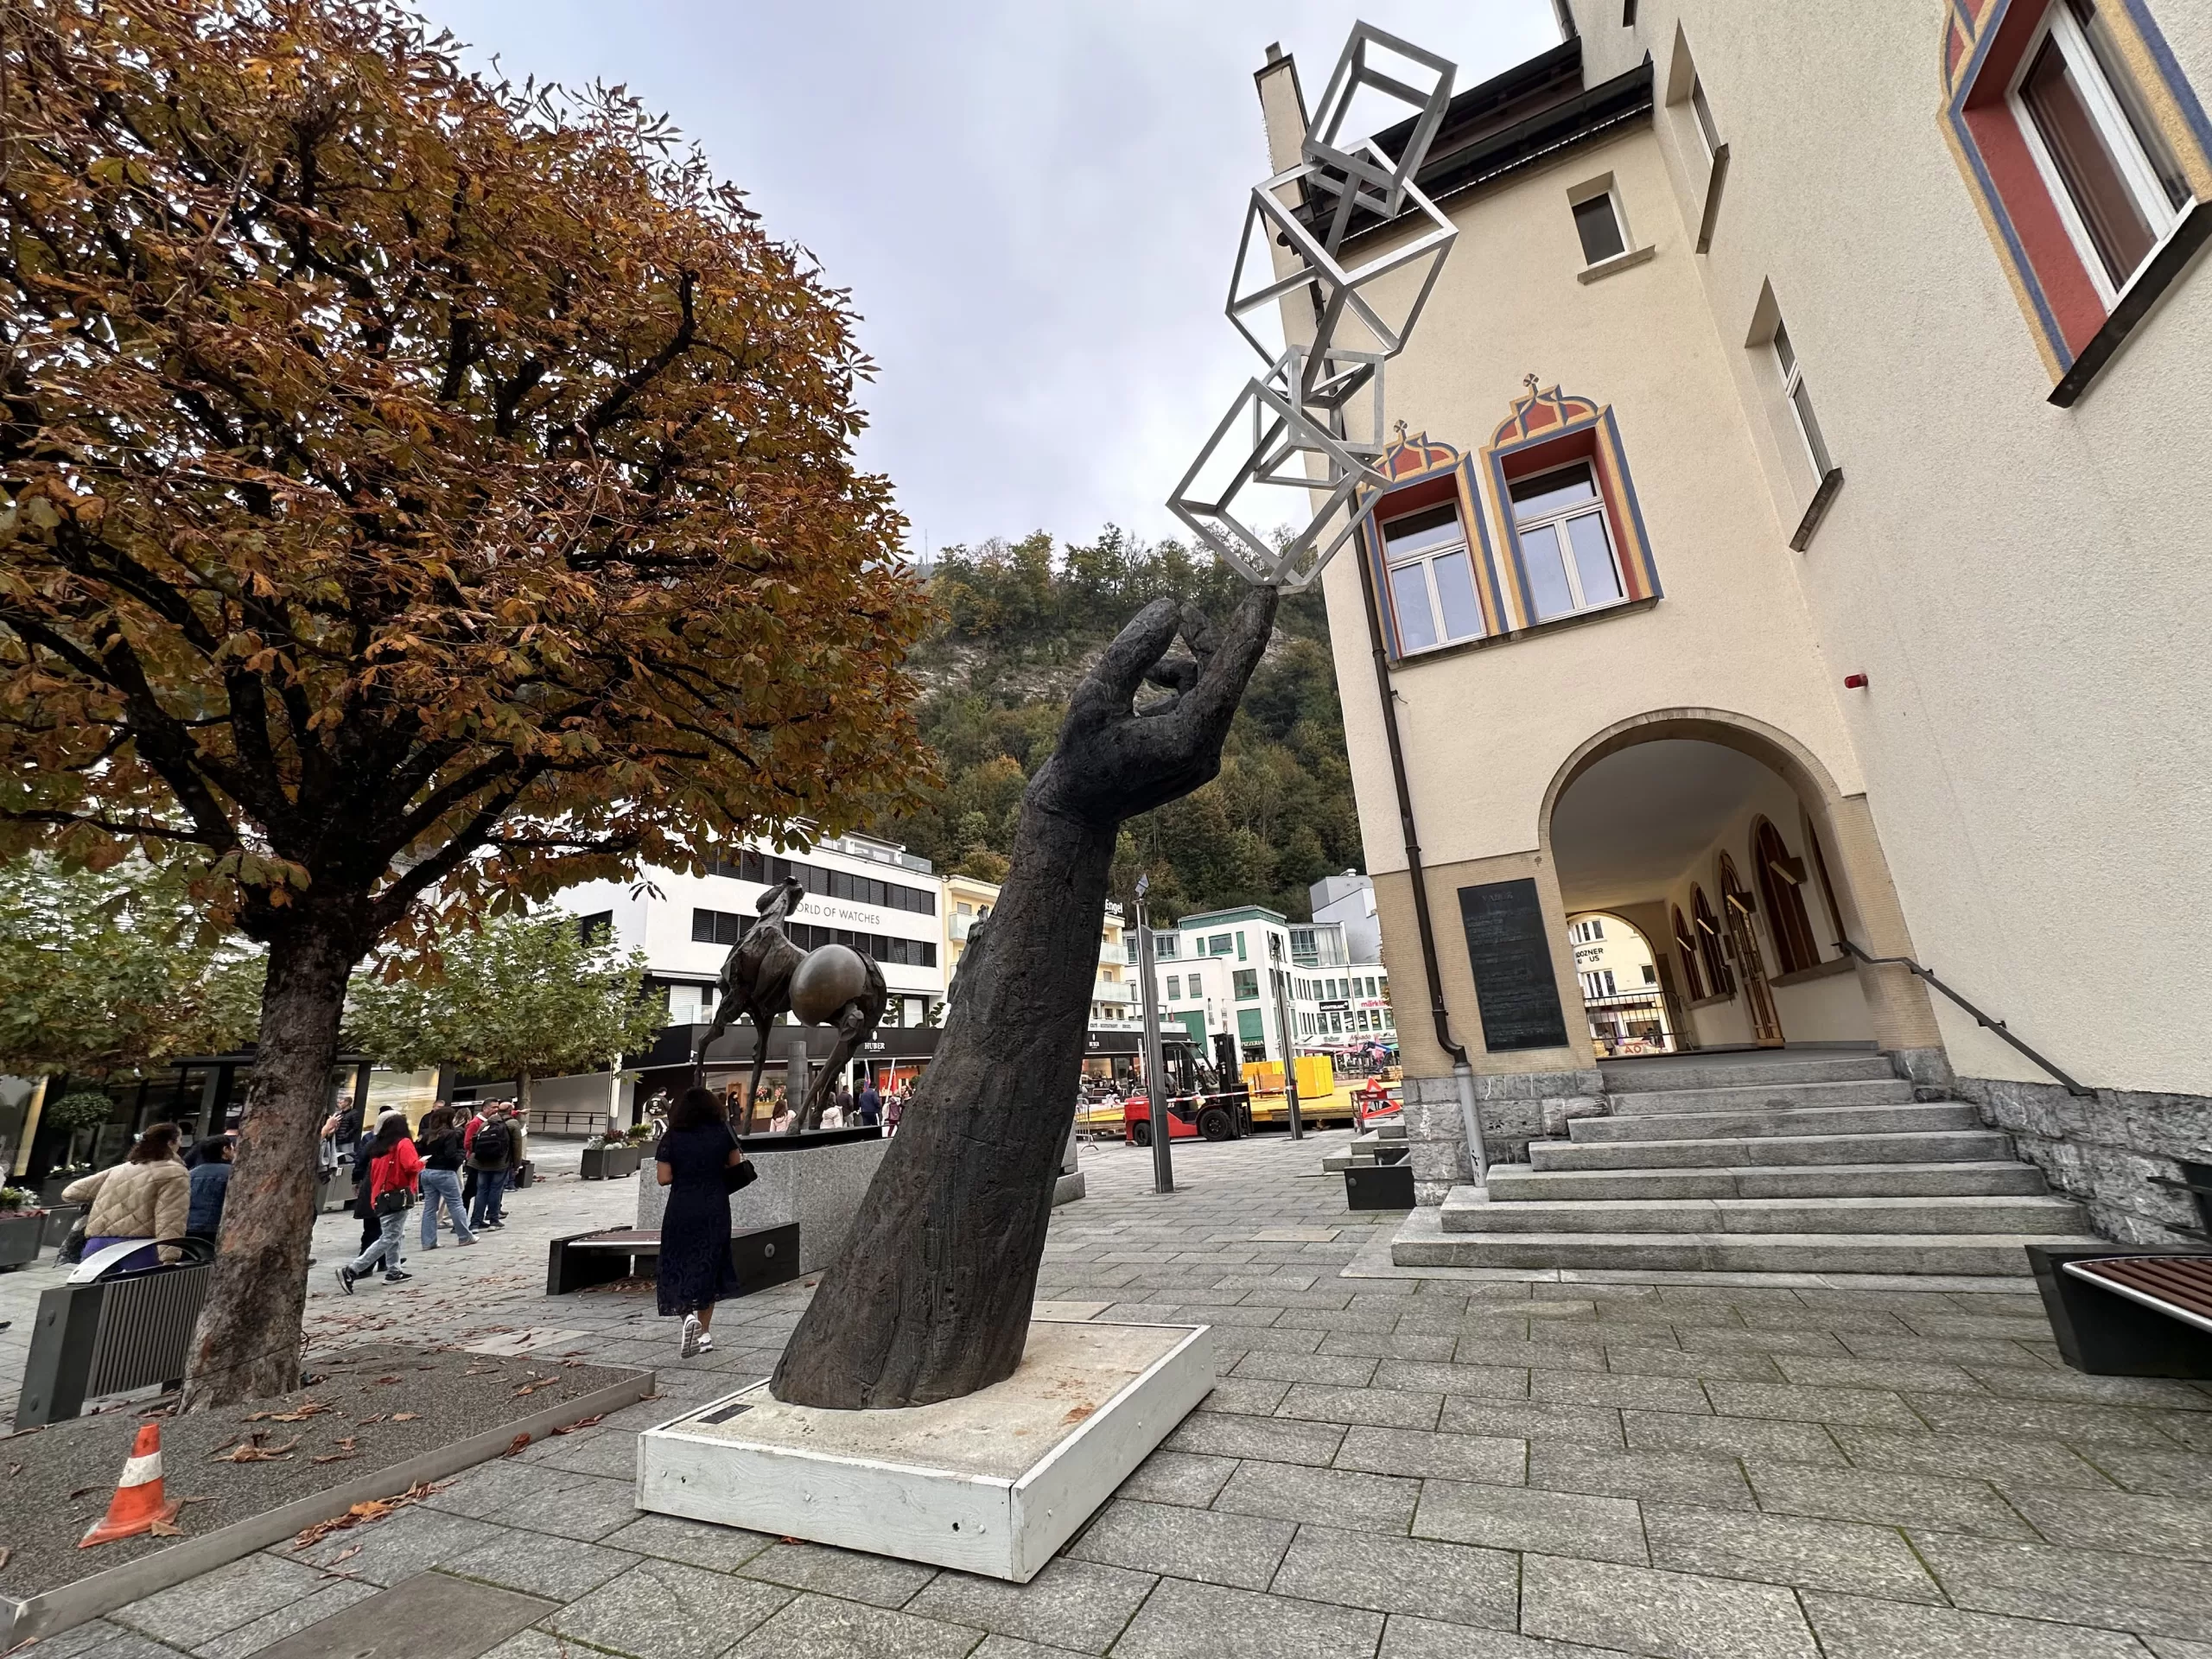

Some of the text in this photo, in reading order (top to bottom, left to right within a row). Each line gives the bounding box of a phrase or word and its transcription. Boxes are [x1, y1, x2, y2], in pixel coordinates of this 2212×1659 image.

[796, 902, 880, 925] ORLD OF WATCHES
[1104, 898, 1123, 915] Engel
